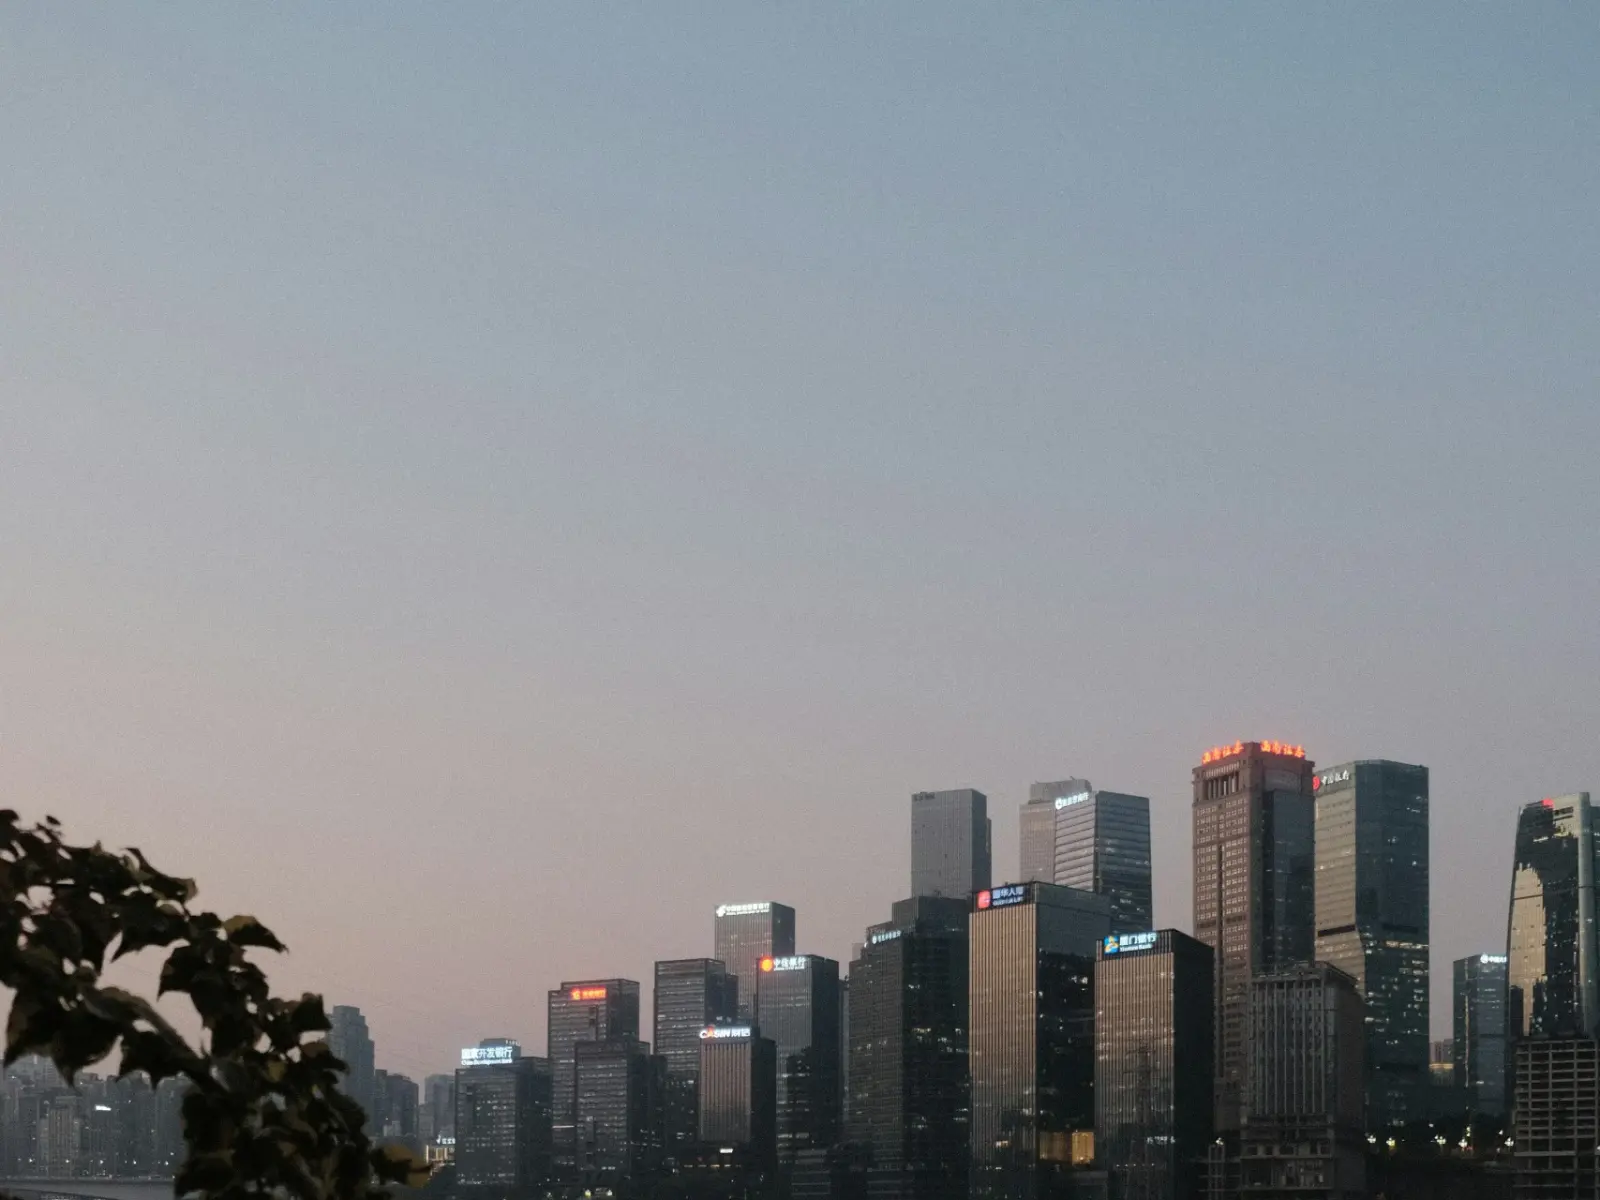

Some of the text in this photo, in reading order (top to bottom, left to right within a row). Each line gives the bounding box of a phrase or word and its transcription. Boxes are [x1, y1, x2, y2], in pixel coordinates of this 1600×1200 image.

[461, 1046, 512, 1059] 国家开发银行
